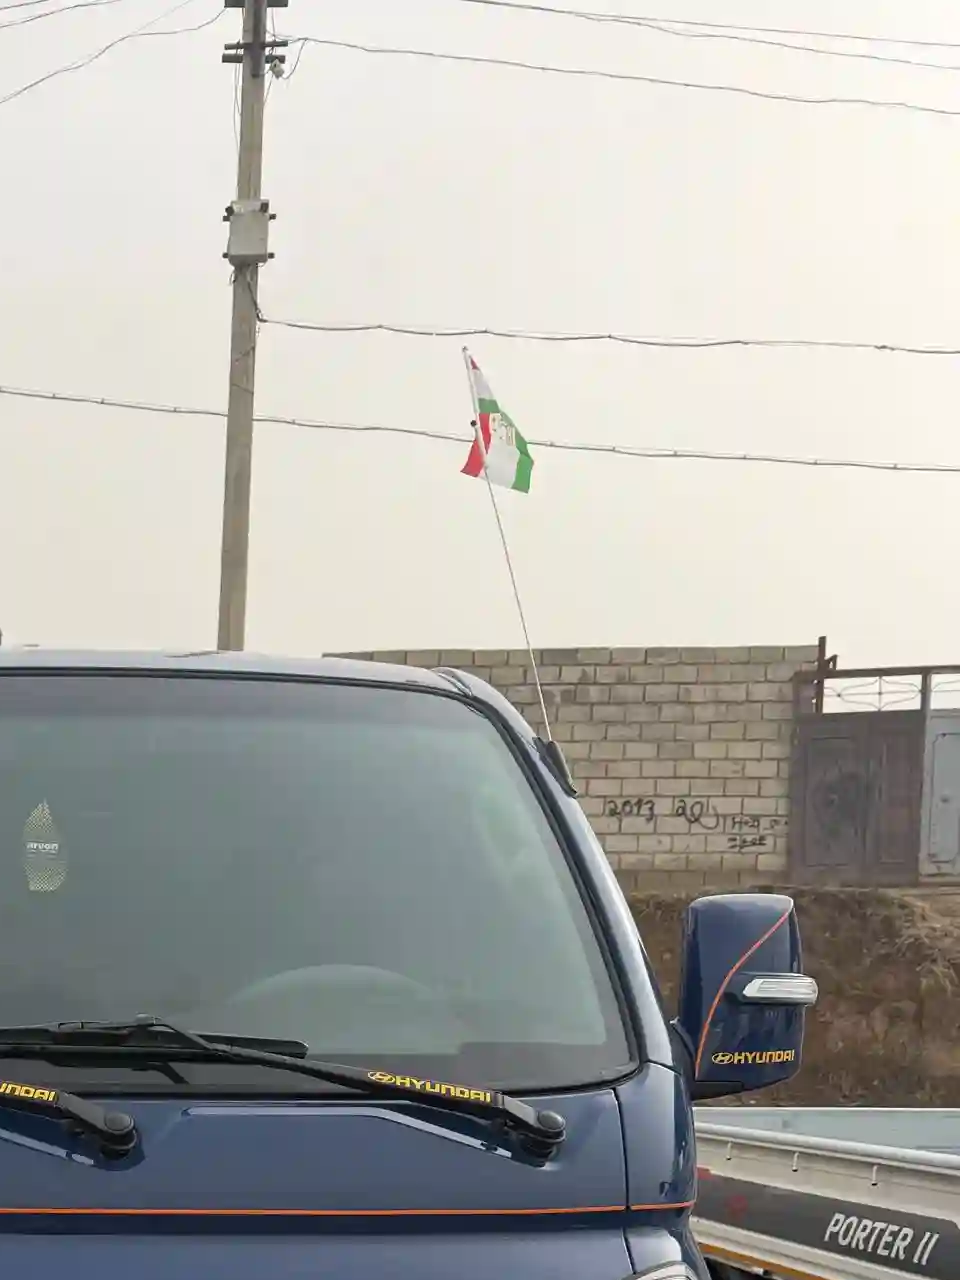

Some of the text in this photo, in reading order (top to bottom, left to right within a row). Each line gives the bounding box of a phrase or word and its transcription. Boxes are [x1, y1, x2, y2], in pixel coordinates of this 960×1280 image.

[733, 1049, 795, 1064] HYUNDAI
[395, 1075, 491, 1102] HYUNDAI
[824, 1212, 940, 1266] PORTER II
